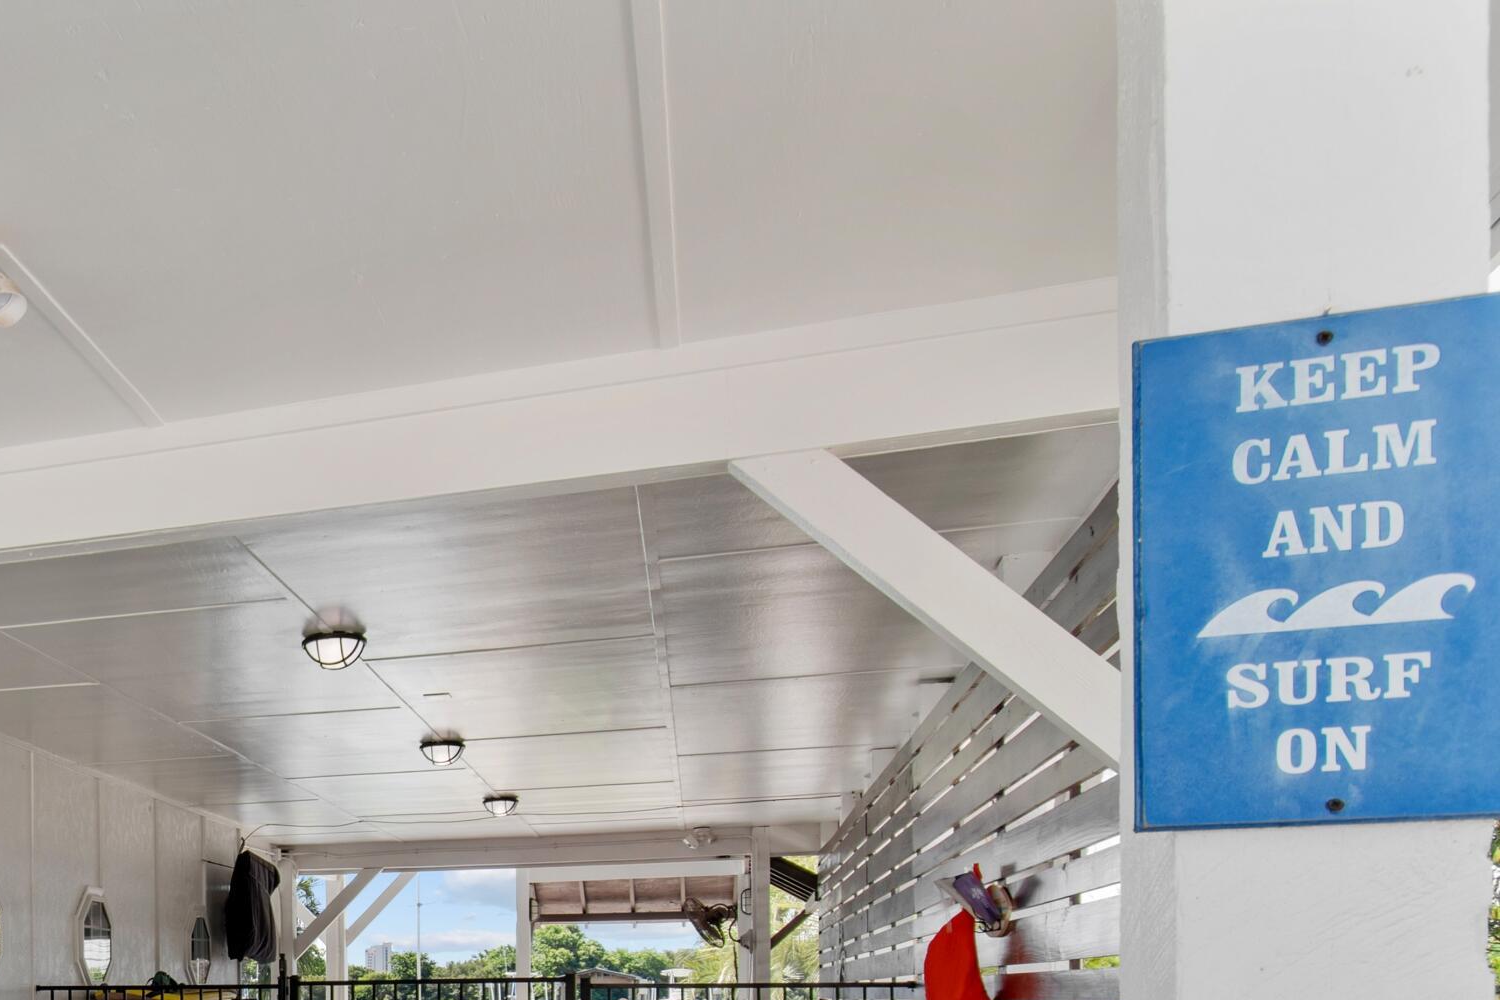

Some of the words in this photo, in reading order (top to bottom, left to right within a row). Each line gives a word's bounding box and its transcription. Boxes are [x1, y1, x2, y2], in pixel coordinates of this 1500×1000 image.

[1235, 343, 1441, 413] KEEP
[1232, 419, 1437, 485] CALM
[1262, 500, 1405, 558] AND
[1226, 651, 1432, 709] SURF
[1276, 725, 1372, 775] ON
